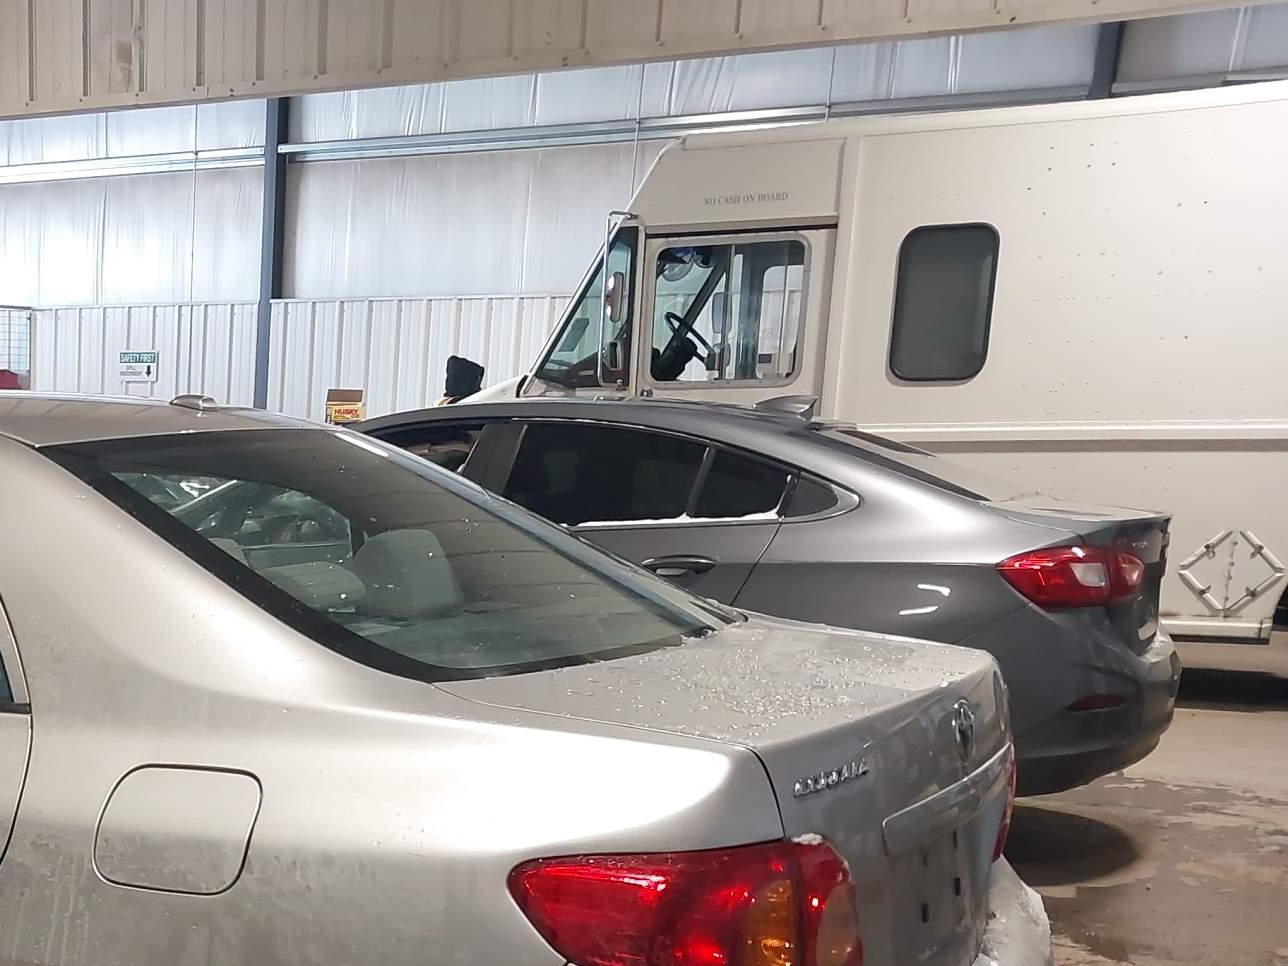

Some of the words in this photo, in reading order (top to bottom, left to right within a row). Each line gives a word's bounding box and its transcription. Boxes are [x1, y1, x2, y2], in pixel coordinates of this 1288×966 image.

[717, 195, 740, 204] CASH
[742, 194, 754, 202] ON
[757, 192, 789, 201] BOARD
[121, 353, 139, 362] SAFETY
[140, 353, 154, 362] FIRST
[334, 408, 360, 416] HUSKY
